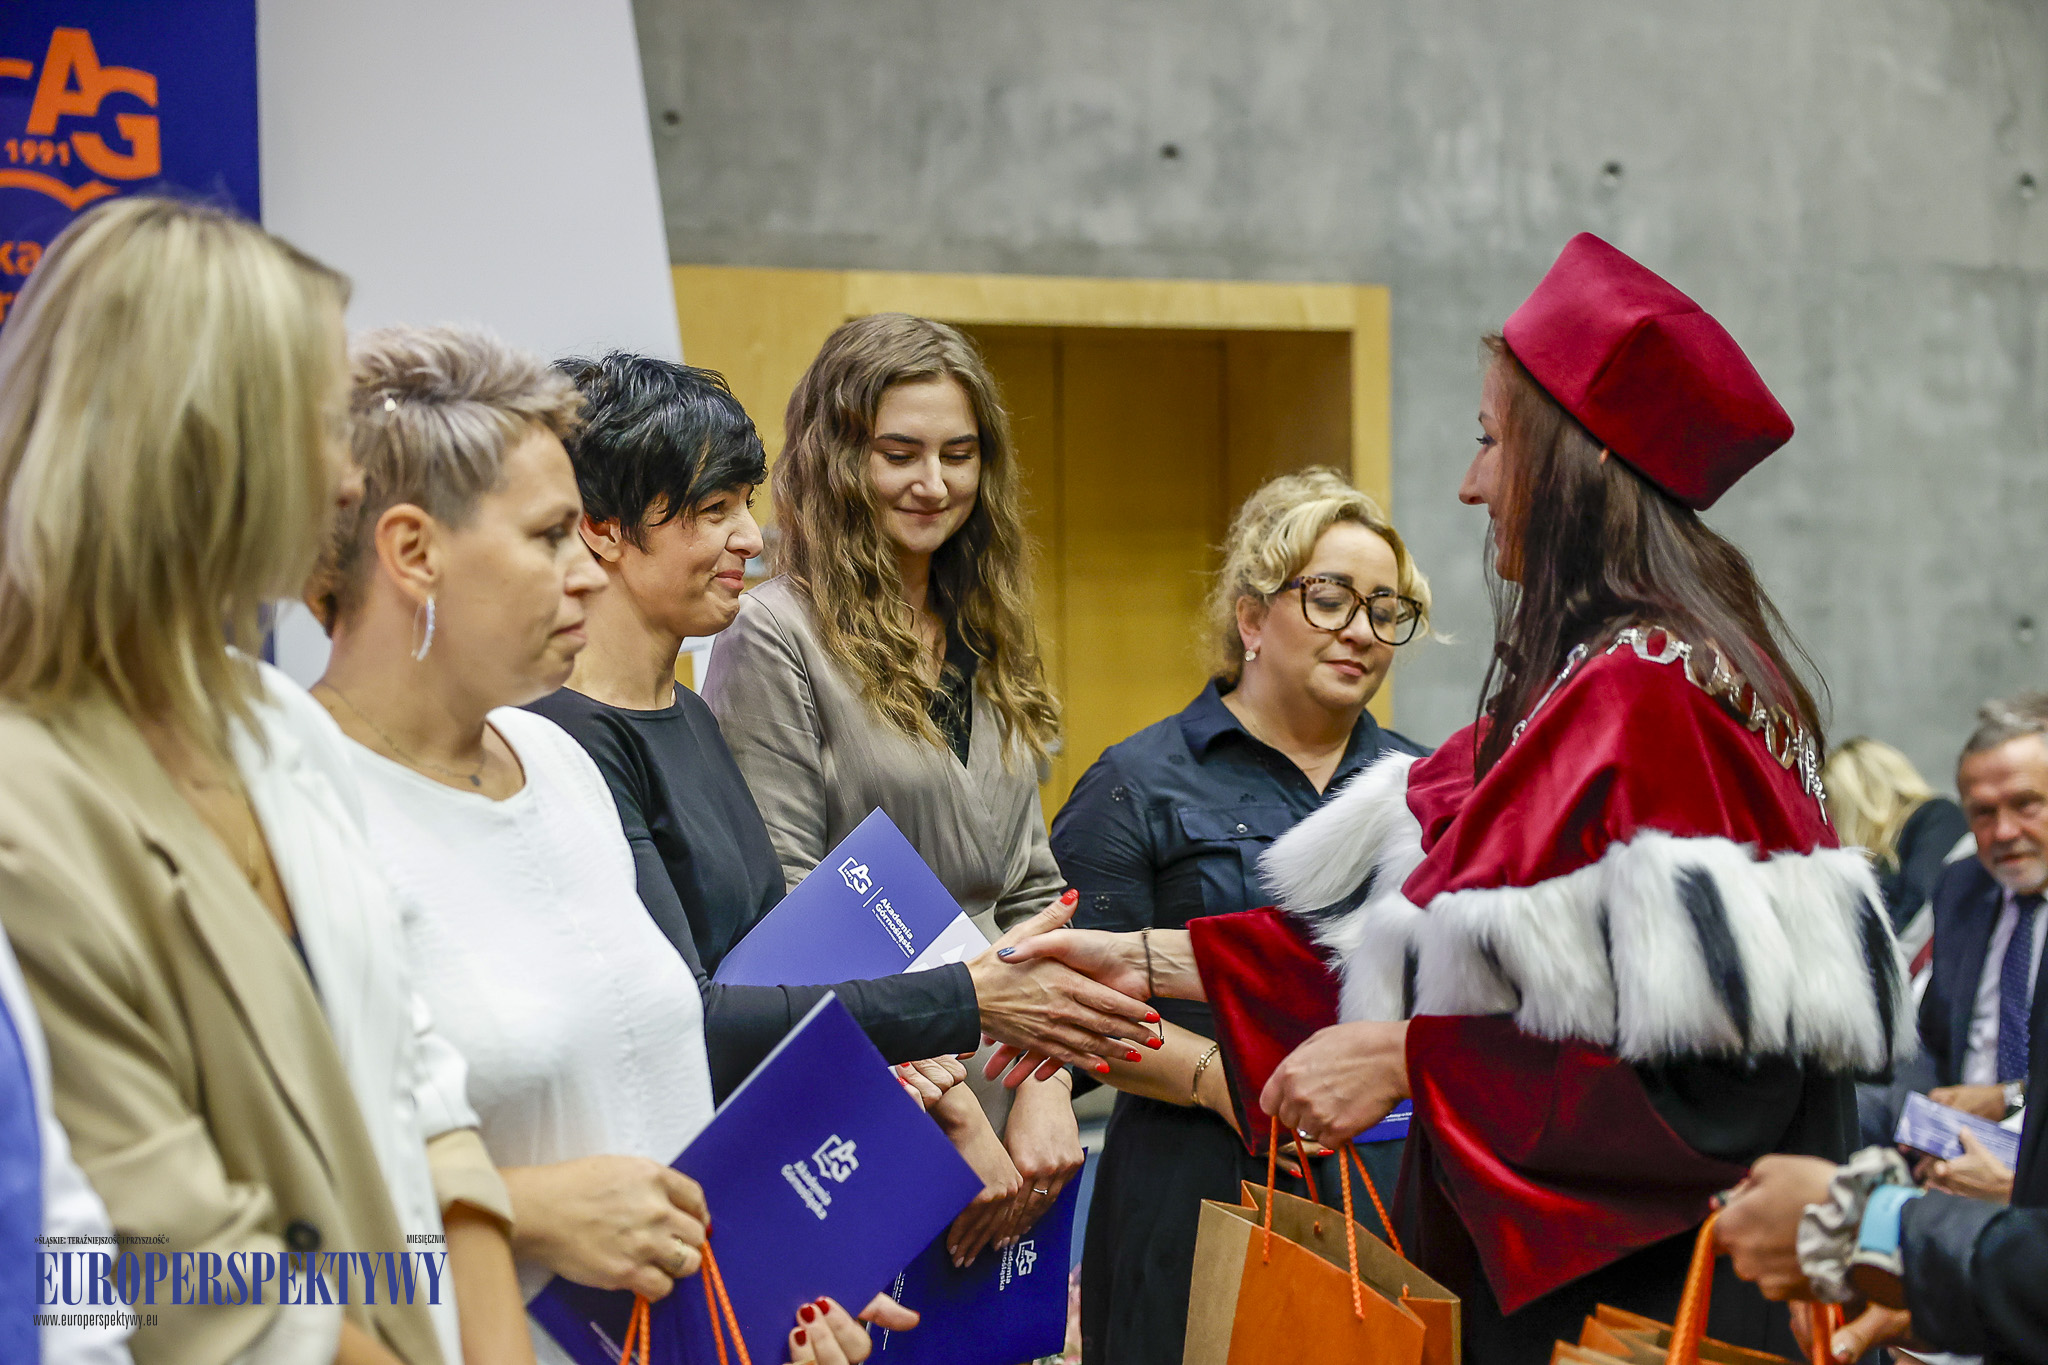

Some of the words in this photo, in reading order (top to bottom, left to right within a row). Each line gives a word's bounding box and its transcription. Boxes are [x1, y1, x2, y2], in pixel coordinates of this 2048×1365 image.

[5, 138, 70, 166] 1991
[875, 903, 915, 955] Górnośląska
[880, 898, 914, 940] Akademia
